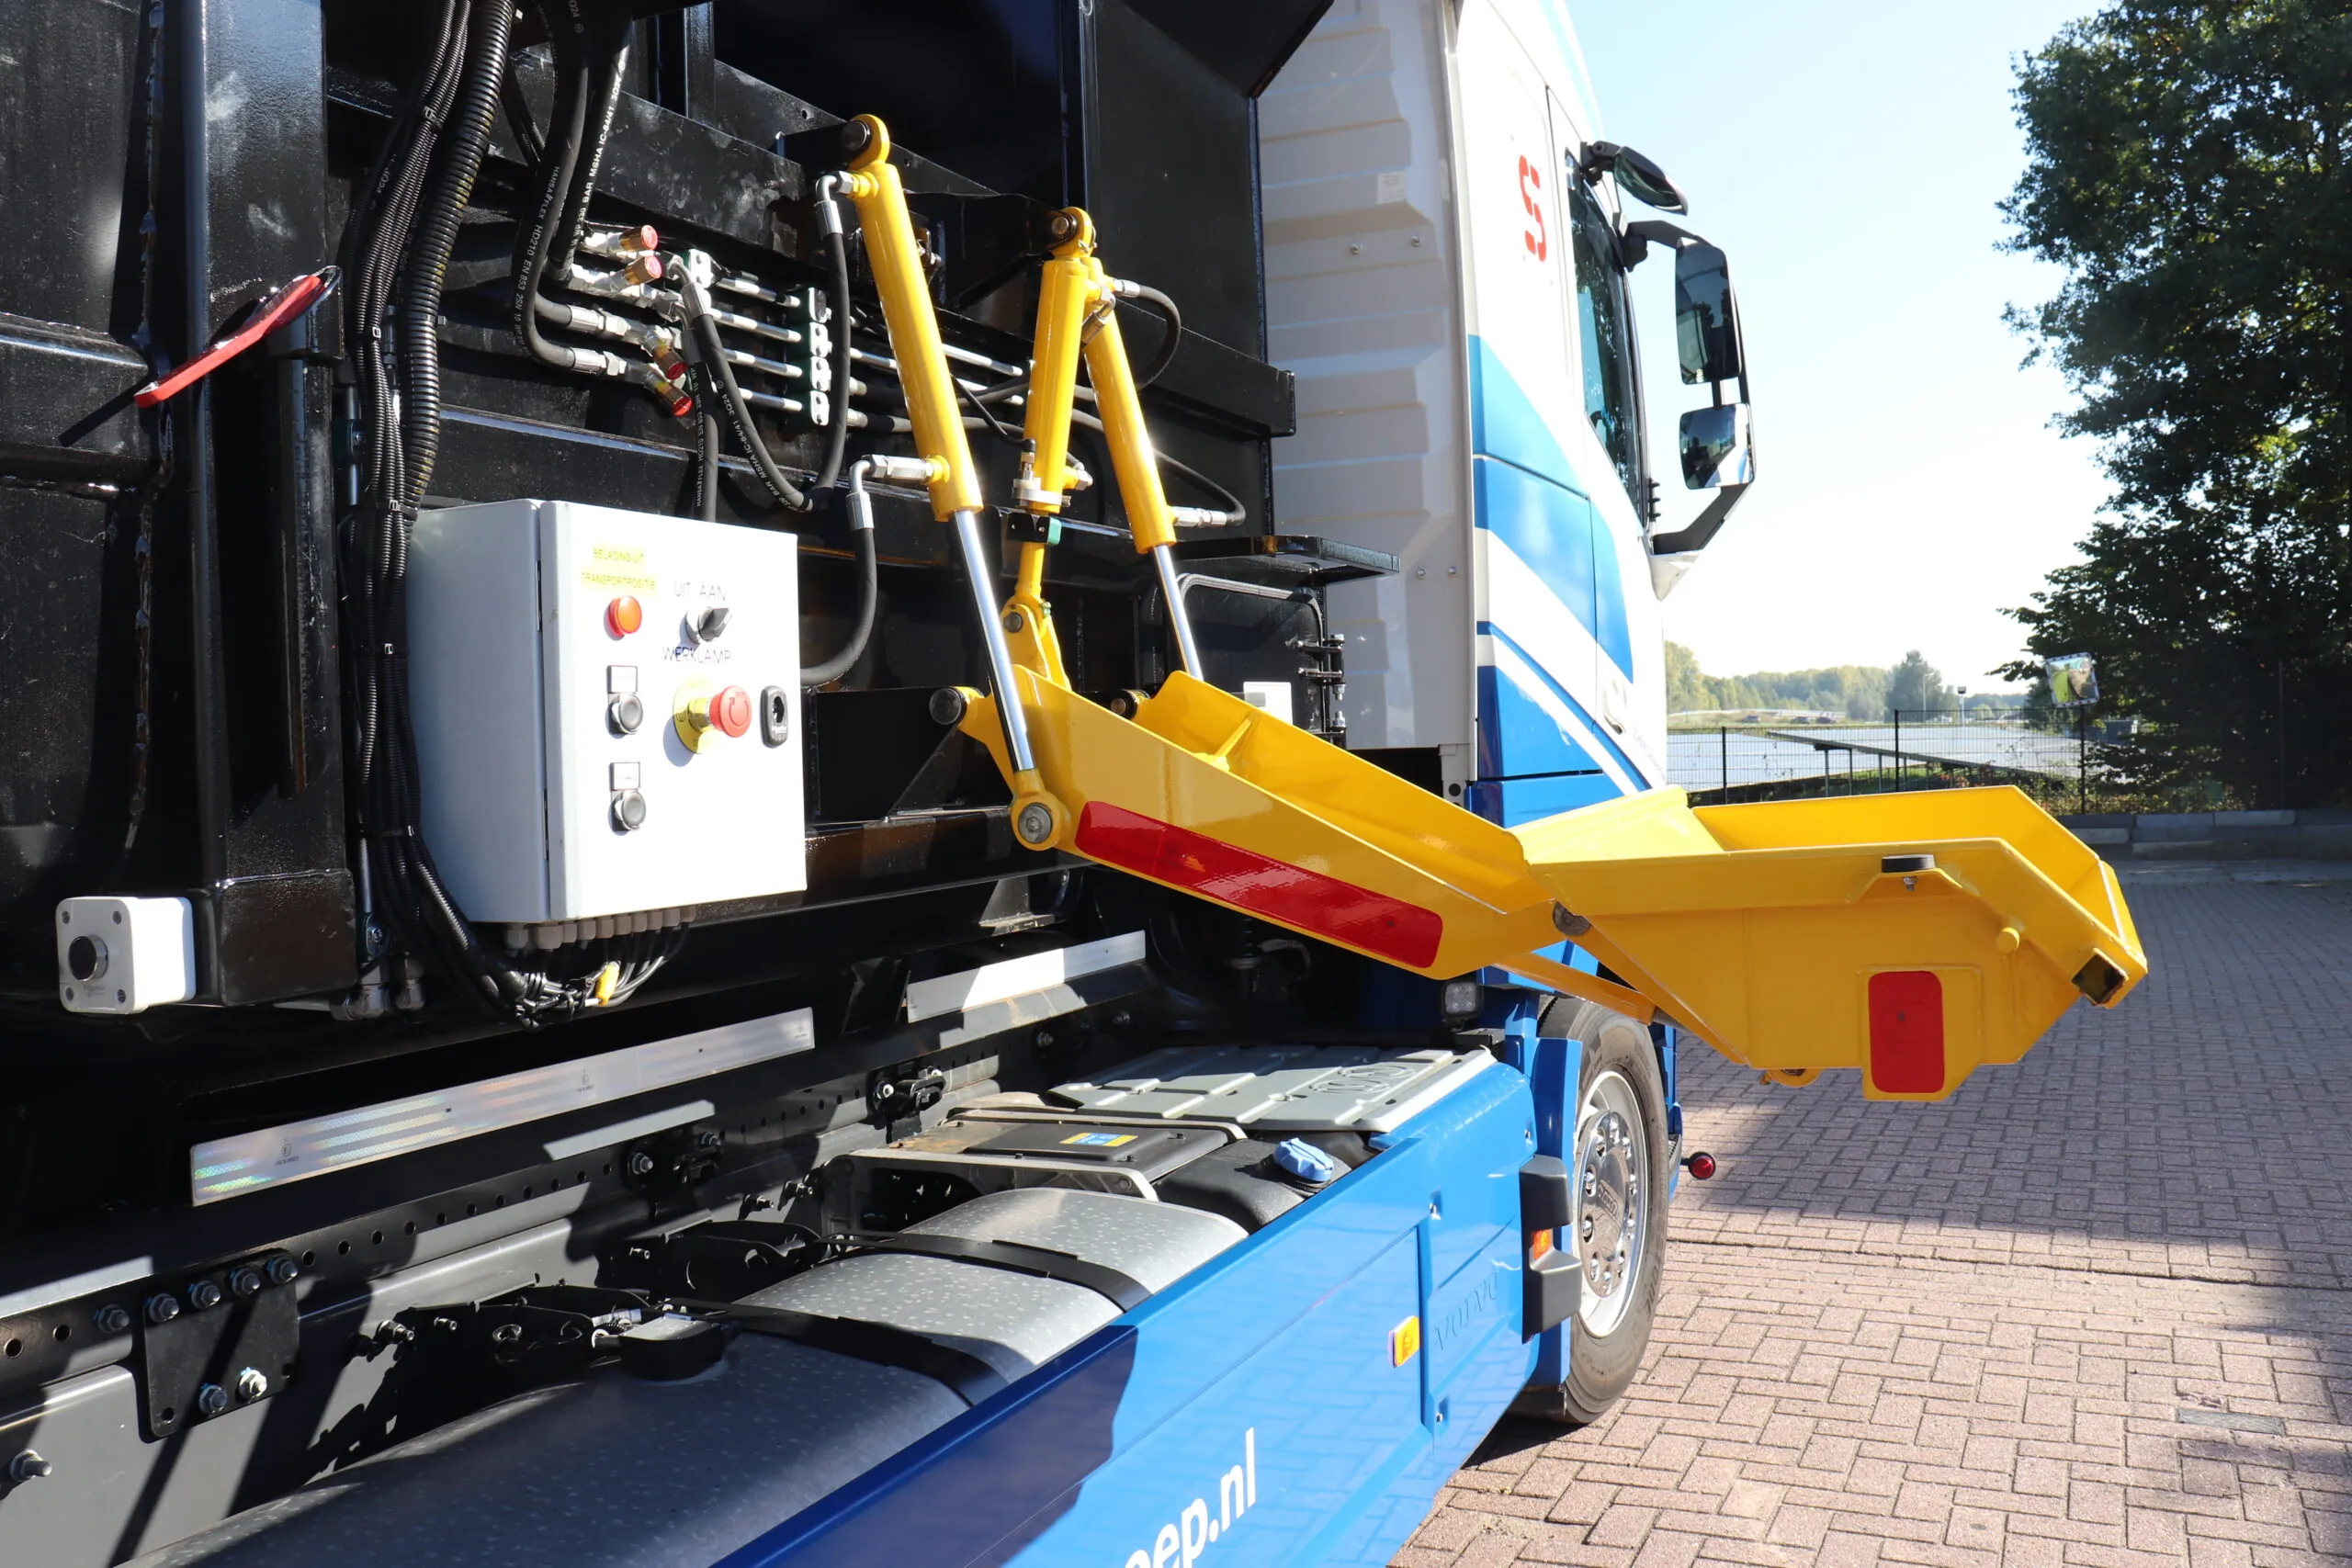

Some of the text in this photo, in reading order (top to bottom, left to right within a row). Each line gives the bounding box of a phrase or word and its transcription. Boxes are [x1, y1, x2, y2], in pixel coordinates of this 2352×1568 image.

[582, 182, 594, 203] BAR
[589, 147, 604, 177] MSHA
[1519, 154, 1546, 262] S
[527, 224, 543, 256] HD210
[523, 260, 532, 274] EN
[520, 275, 528, 290] 853
[721, 393, 735, 416] 3Q24
[749, 456, 767, 479] MSHA
[765, 480, 780, 497] BAR
[673, 581, 727, 601] UIT AAN
[662, 646, 731, 664] WERKLAMP
